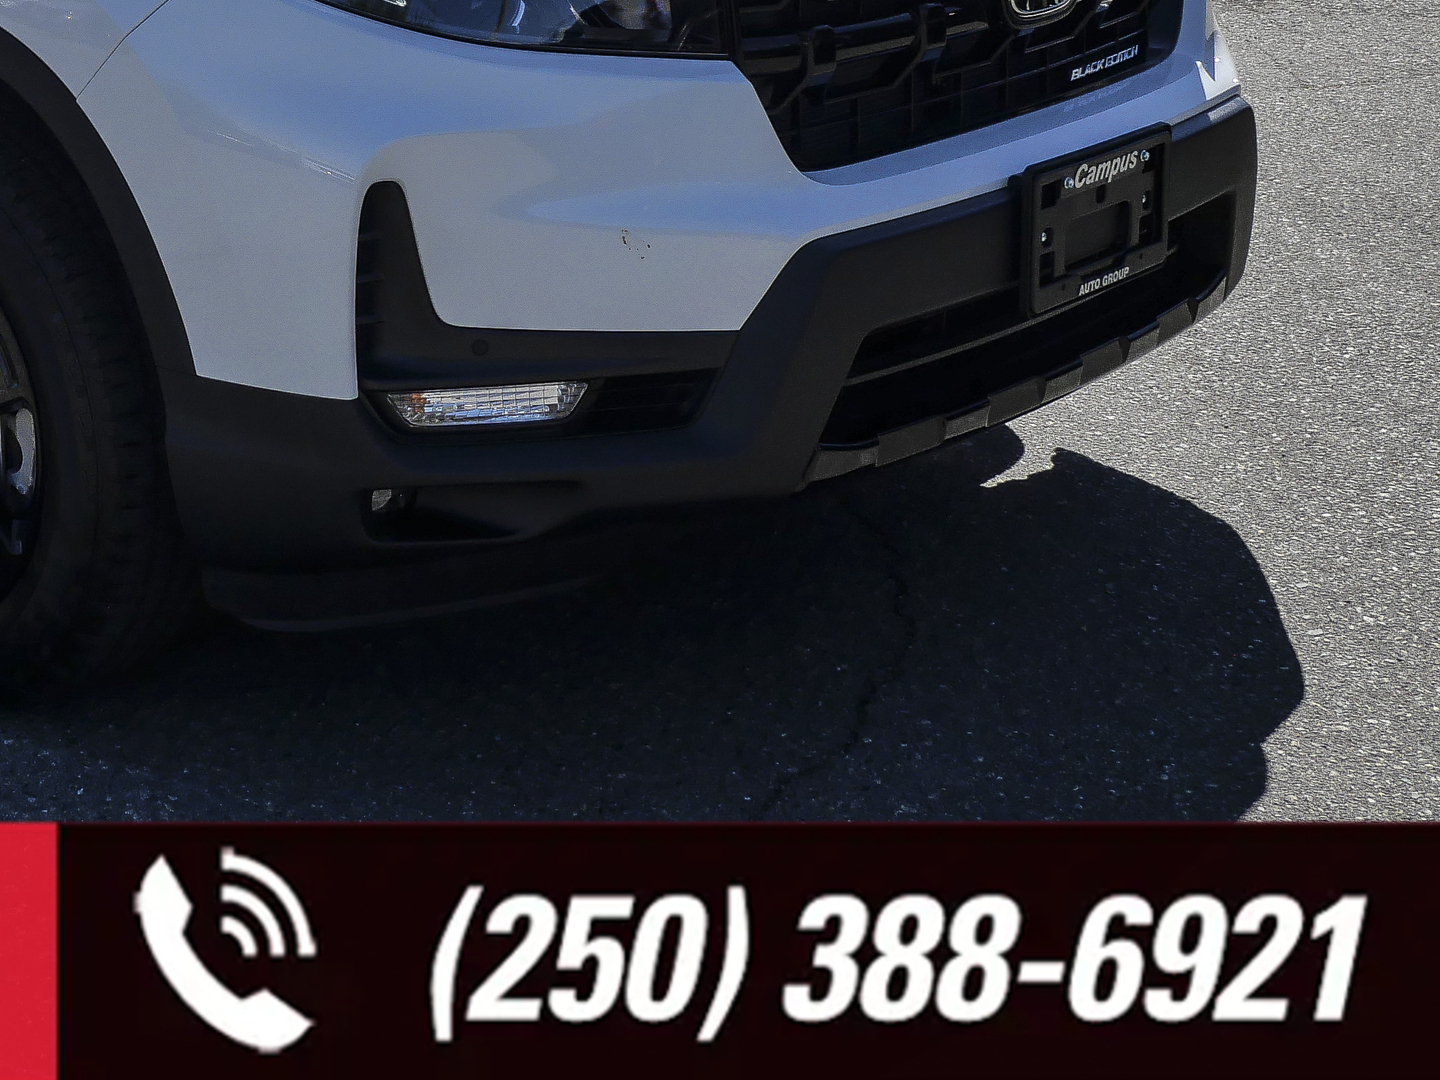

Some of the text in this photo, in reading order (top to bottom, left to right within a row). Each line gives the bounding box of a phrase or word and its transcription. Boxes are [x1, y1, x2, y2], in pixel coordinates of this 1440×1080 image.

[1070, 58, 1105, 81] BLACK
[1074, 150, 1139, 188] Campus
[1078, 266, 1130, 296] AUTO GROUP
